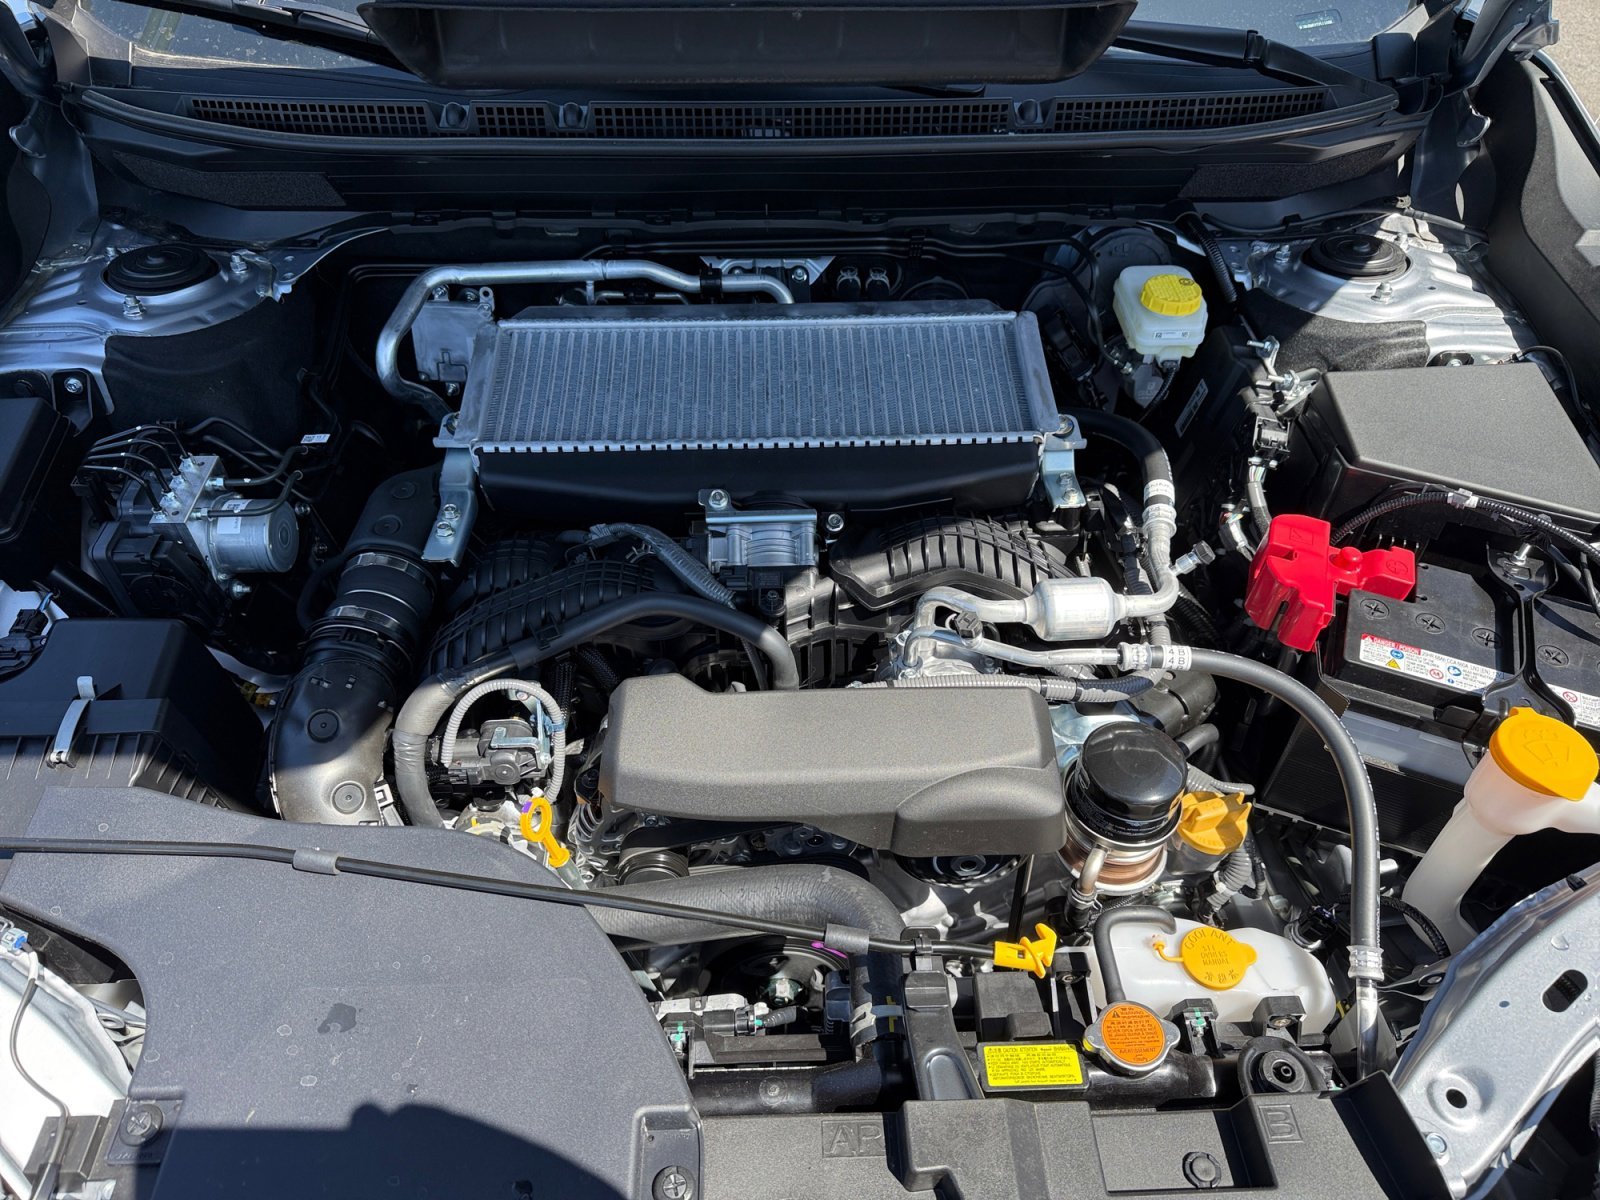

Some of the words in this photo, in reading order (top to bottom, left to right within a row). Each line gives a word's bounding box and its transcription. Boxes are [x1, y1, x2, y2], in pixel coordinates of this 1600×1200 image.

[1184, 929, 1236, 950] COOLANT
[1202, 958, 1229, 966] MANUAL
[1264, 1109, 1296, 1138] B
